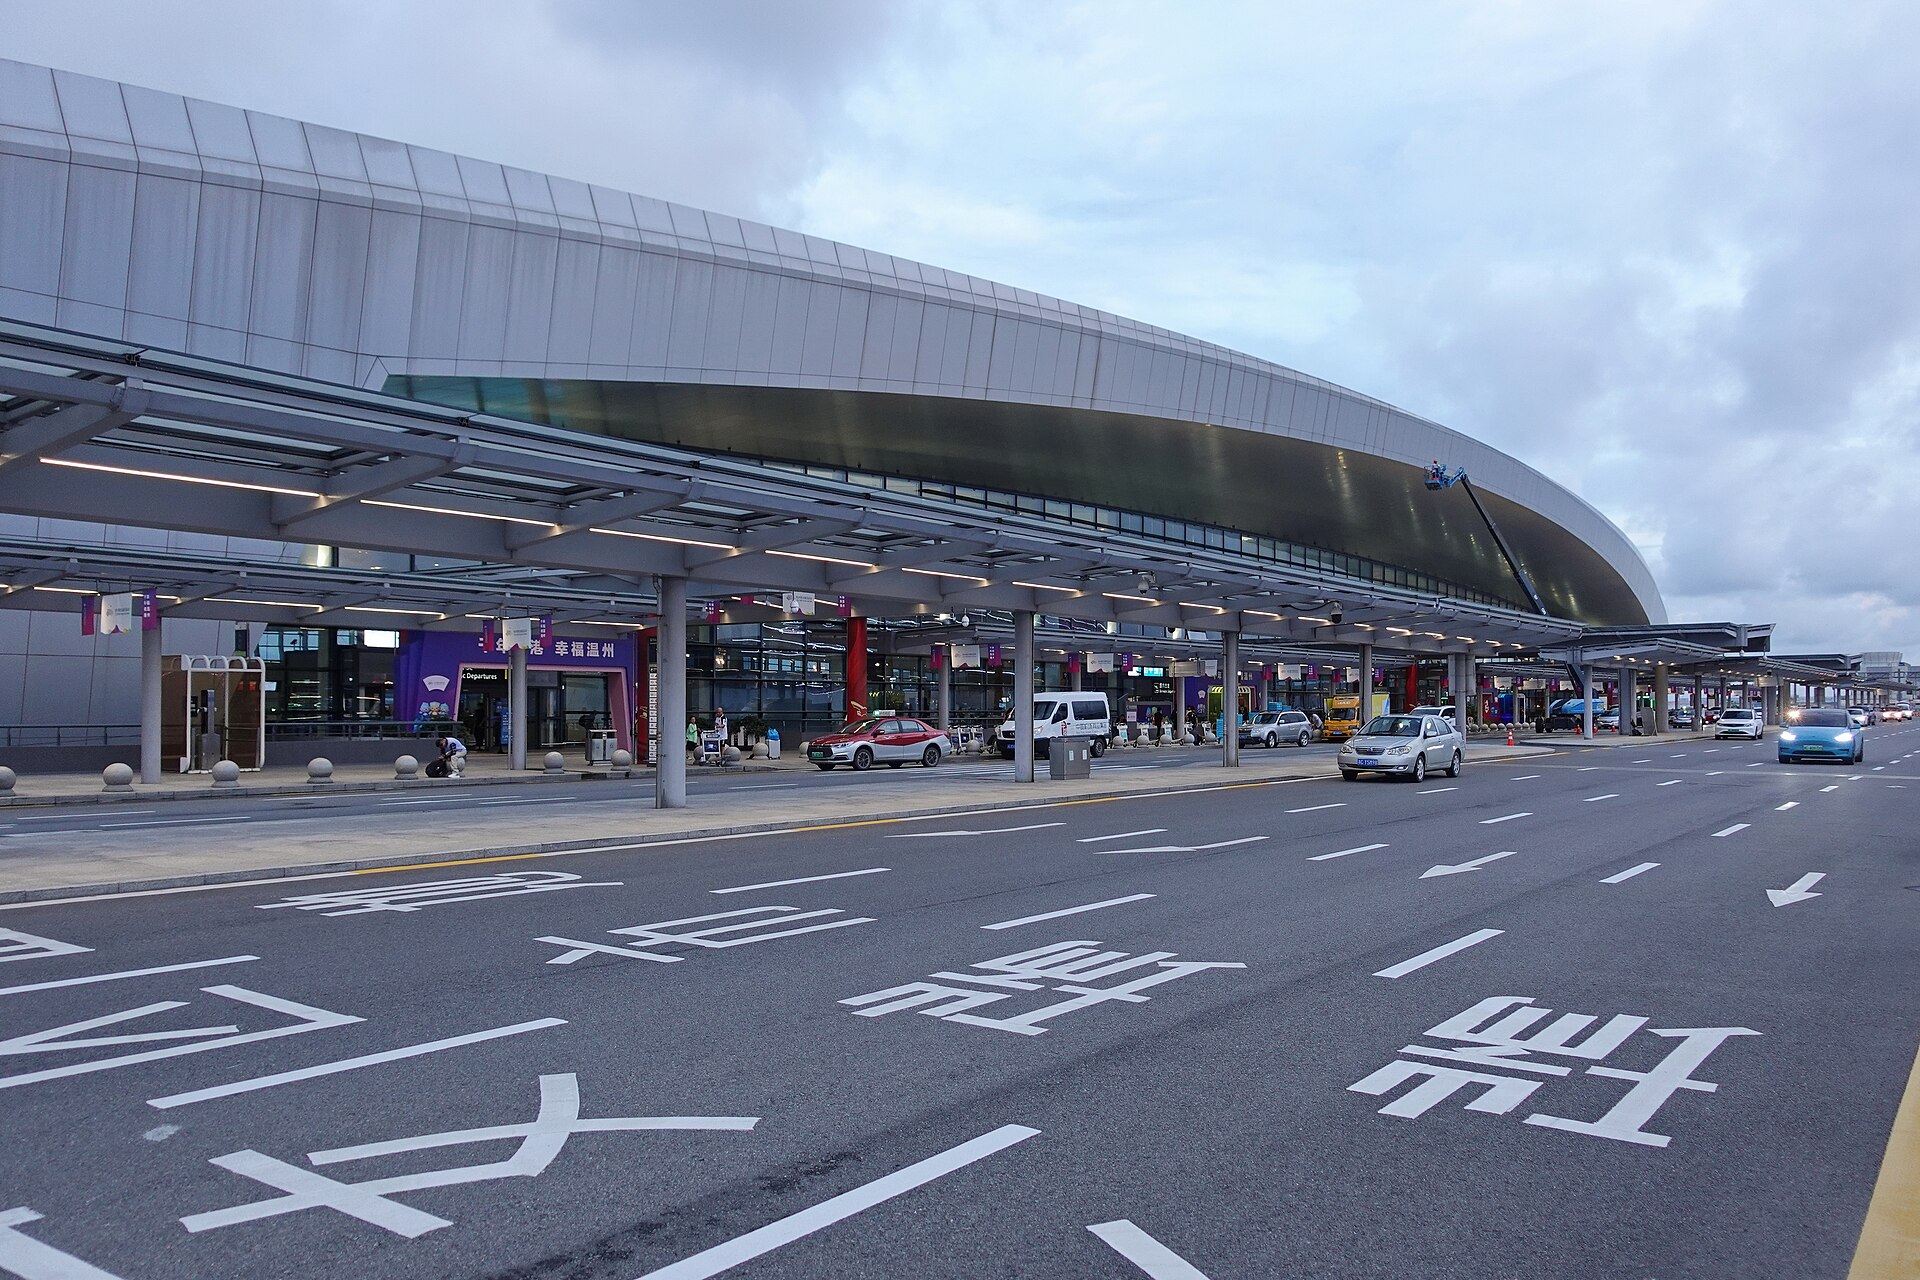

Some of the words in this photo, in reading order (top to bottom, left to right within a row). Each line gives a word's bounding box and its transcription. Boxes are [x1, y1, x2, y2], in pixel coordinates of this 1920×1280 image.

[555, 640, 614, 658] 幸福温州
[466, 672, 497, 680] Departures
